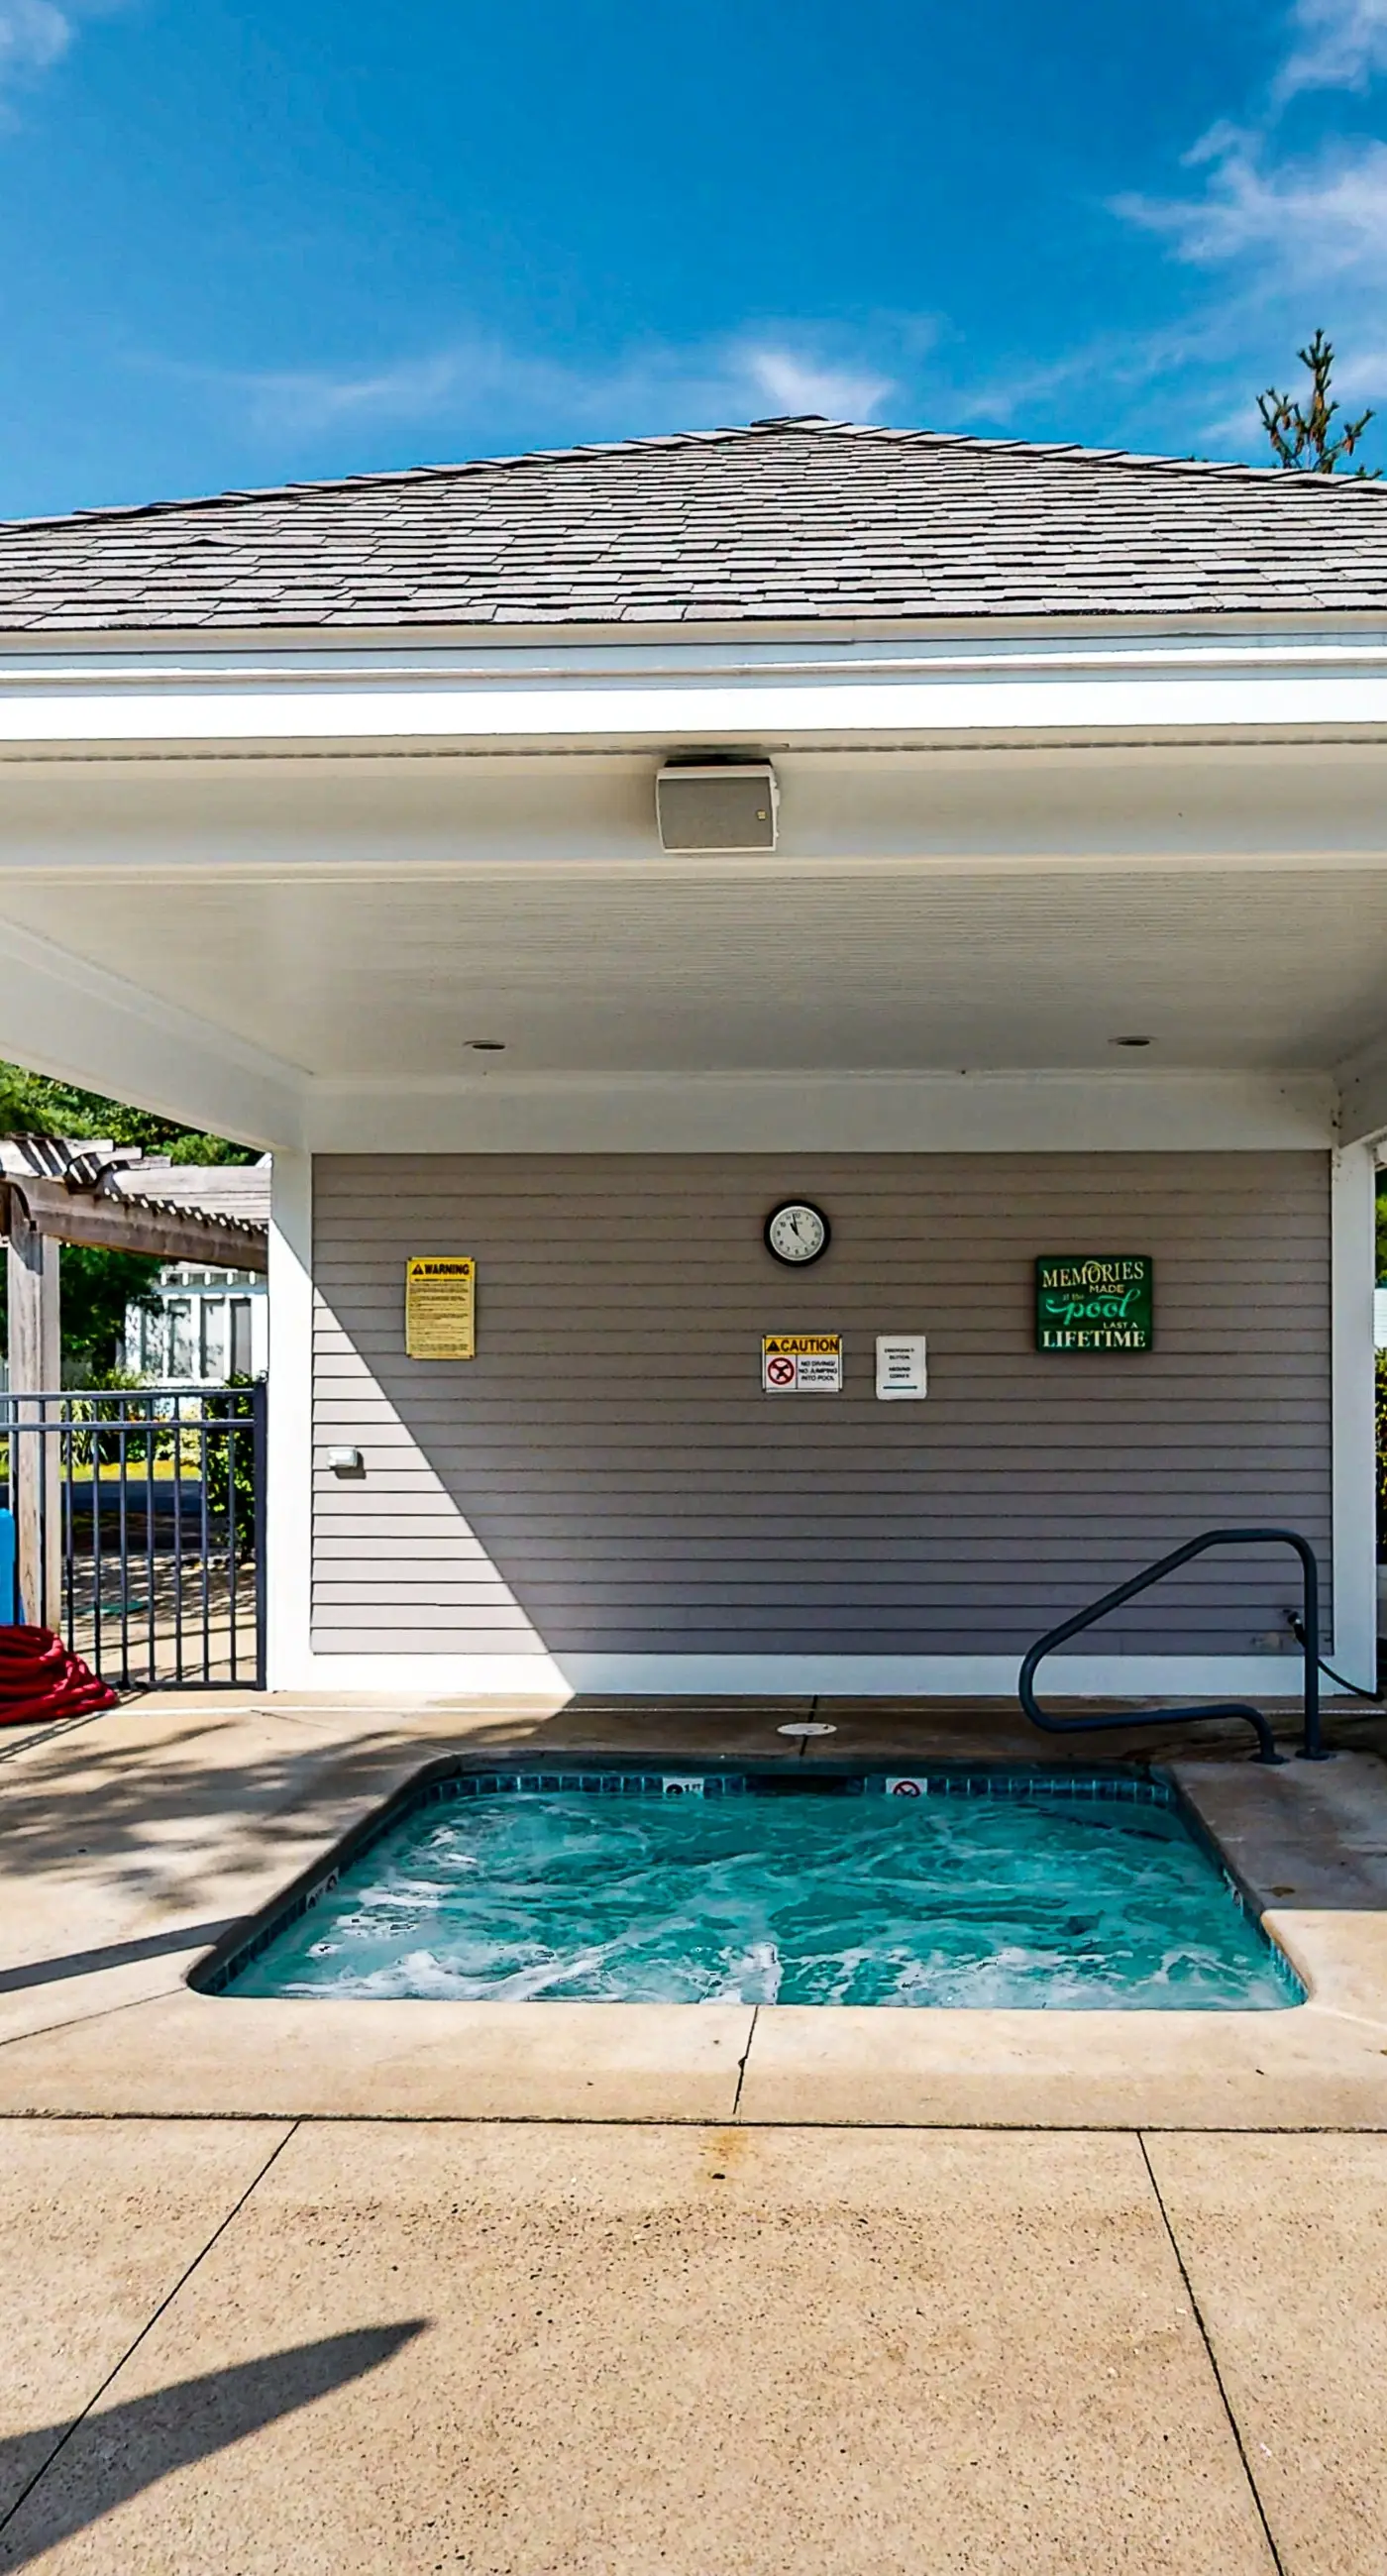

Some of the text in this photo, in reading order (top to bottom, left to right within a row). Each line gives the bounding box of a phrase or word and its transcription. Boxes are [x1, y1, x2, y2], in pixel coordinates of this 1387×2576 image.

[424, 1263, 470, 1275] WARNING
[1042, 1260, 1144, 1288] MEMORIES
[1089, 1284, 1125, 1293] MADE
[1046, 1288, 1141, 1326] pool
[781, 1339, 839, 1352] CAUTION
[1042, 1331, 1145, 1347] LIFETIME
